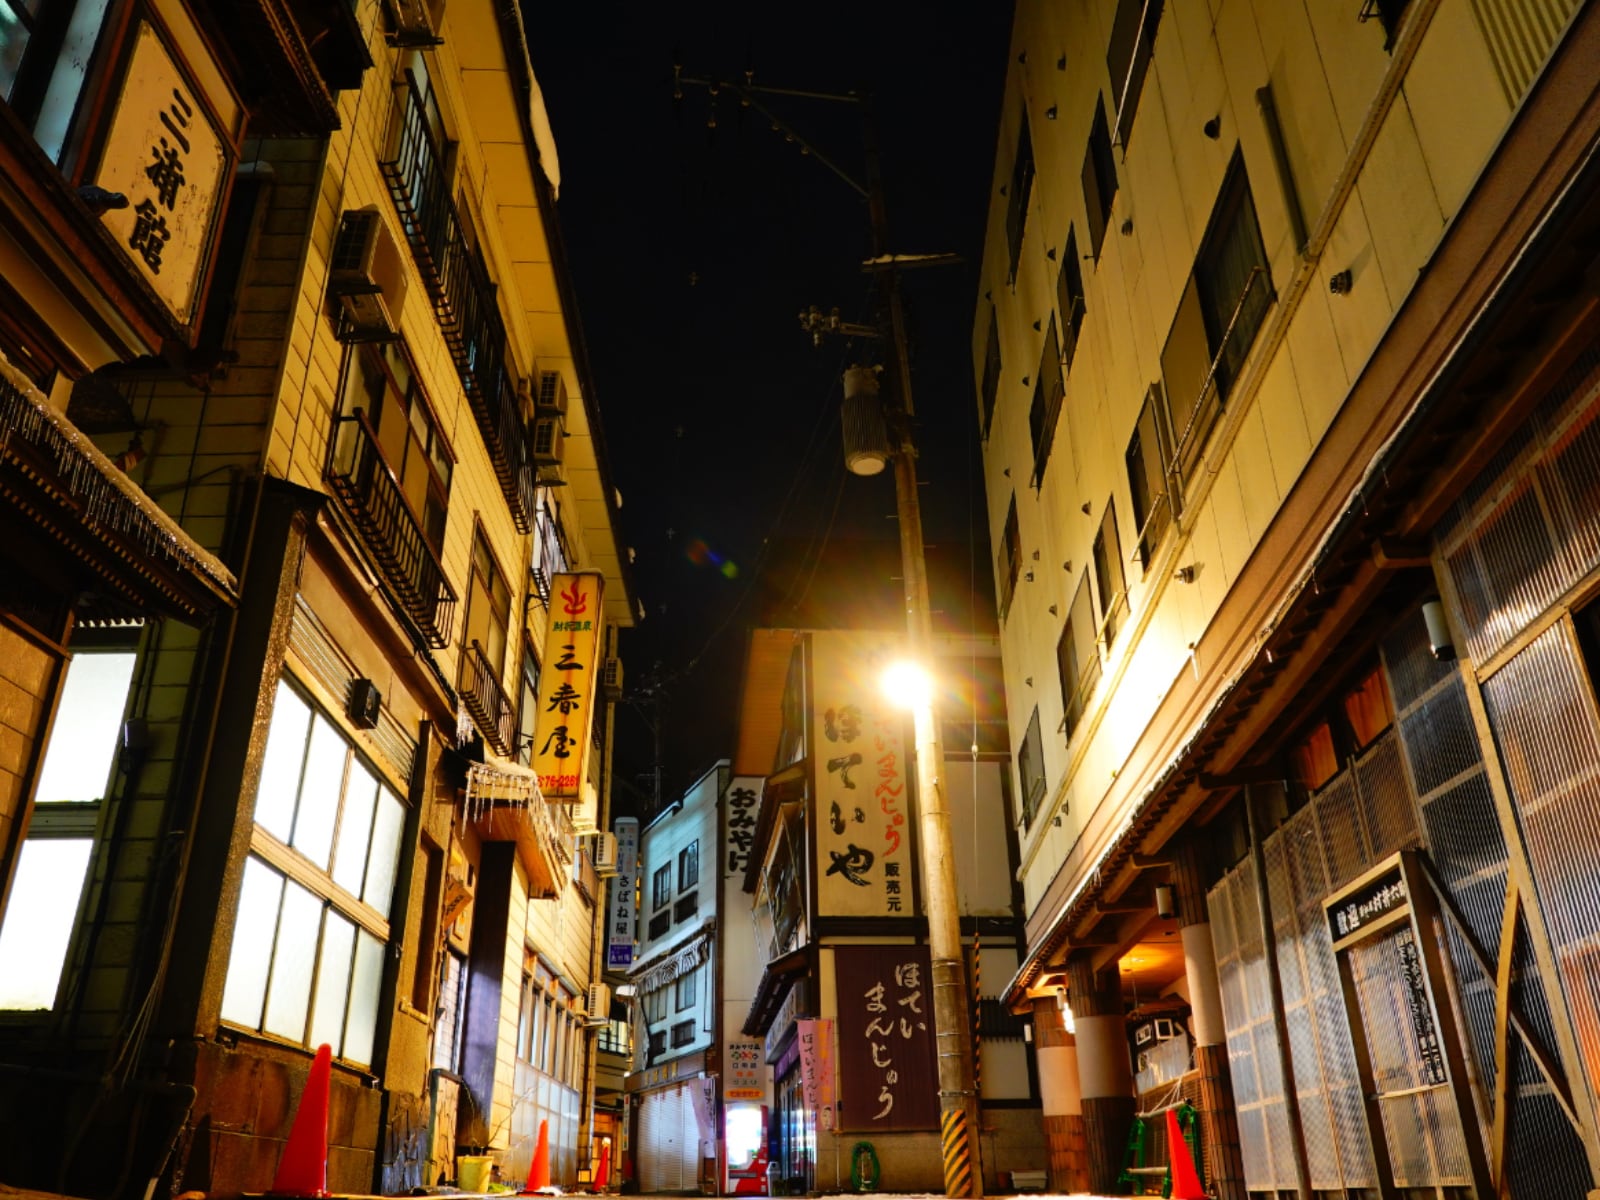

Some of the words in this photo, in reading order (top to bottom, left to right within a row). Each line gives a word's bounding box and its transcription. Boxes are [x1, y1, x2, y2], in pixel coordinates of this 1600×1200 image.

[540, 645, 584, 759] 三春屋
[824, 704, 874, 887] ほていや
[873, 712, 904, 858] ていまんじゅう
[615, 875, 632, 935] さばね屋
[885, 862, 902, 912] 販売元
[863, 981, 899, 1121] まんじゅう
[895, 962, 927, 1040] ほてい
